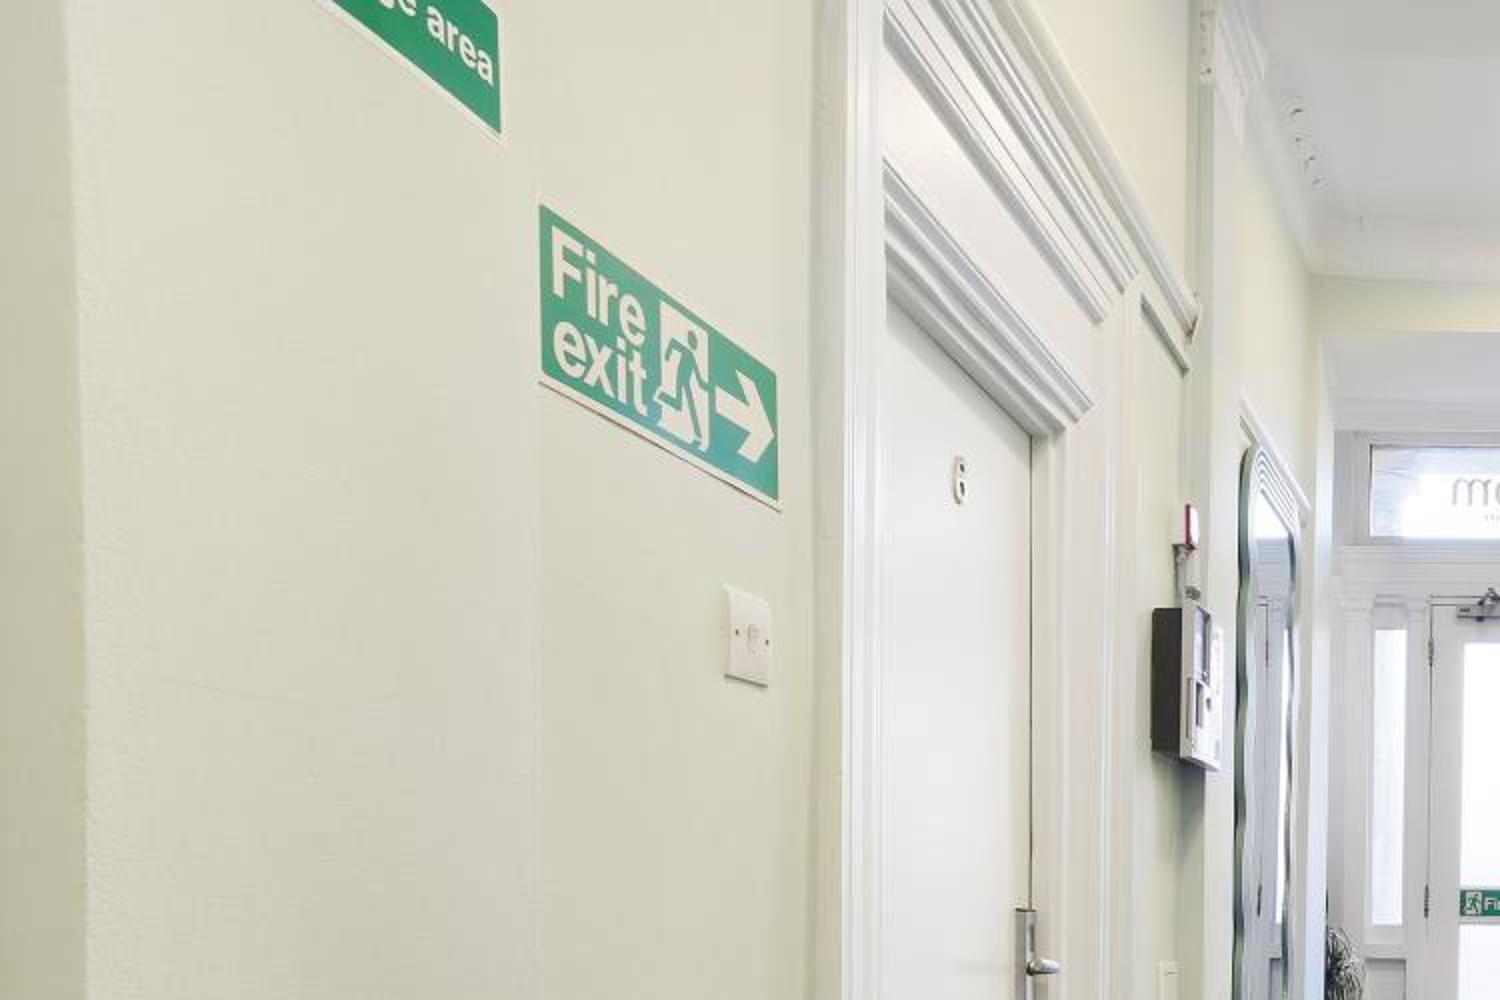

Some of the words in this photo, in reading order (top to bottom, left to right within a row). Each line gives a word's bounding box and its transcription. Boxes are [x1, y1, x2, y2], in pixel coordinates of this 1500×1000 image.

[428, 5, 493, 86] area
[552, 226, 646, 345] Fire
[554, 321, 648, 414] exit
